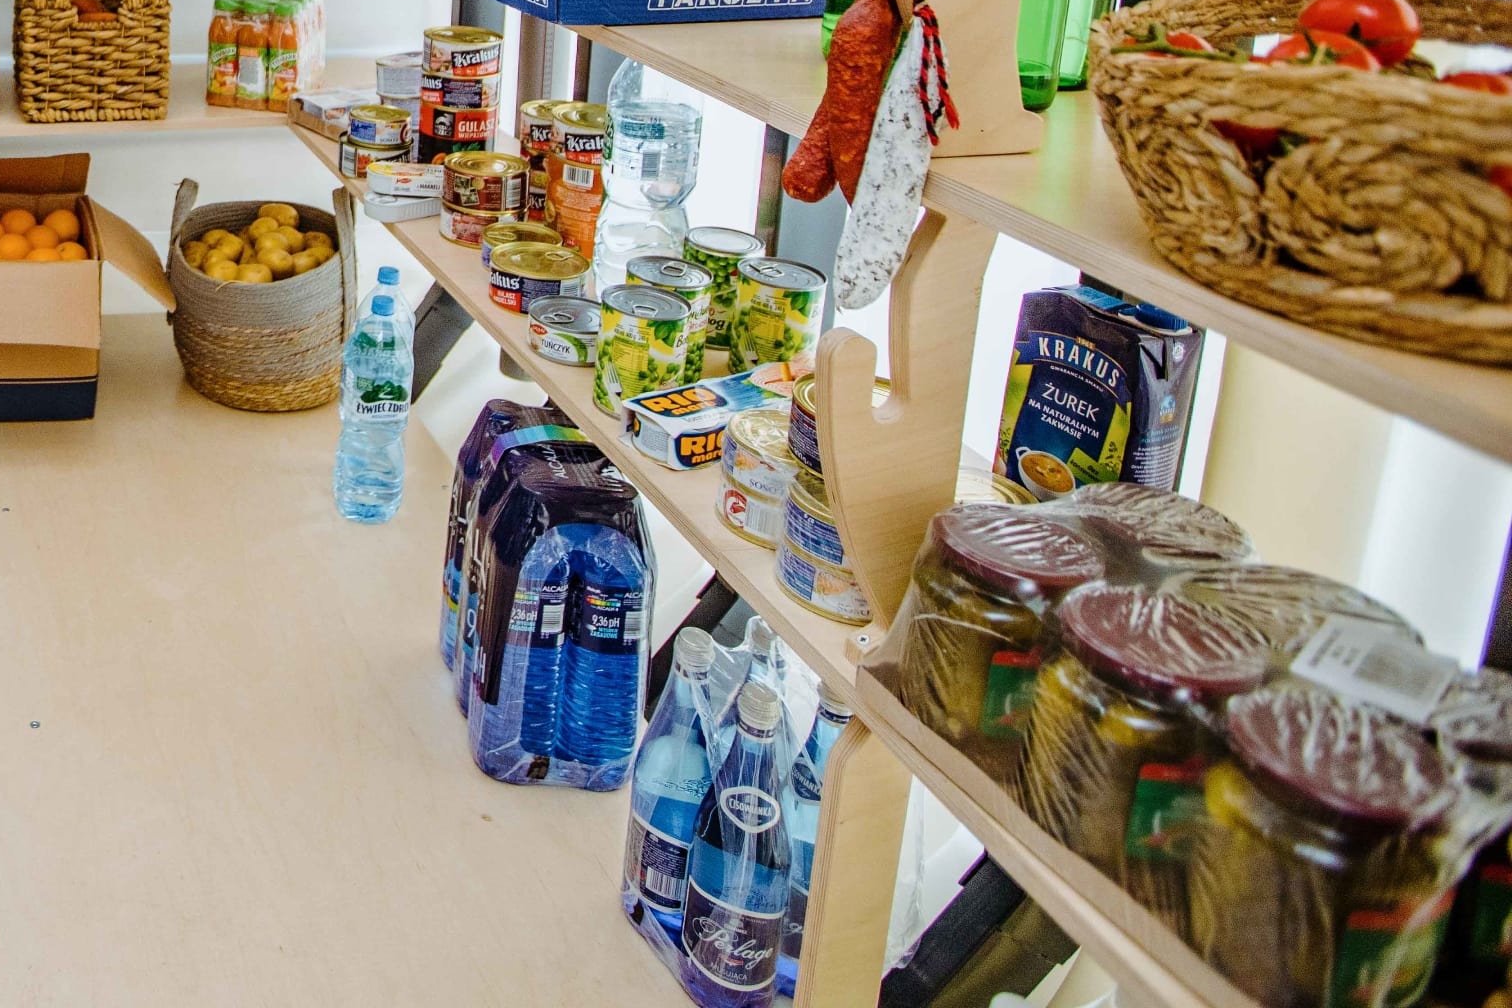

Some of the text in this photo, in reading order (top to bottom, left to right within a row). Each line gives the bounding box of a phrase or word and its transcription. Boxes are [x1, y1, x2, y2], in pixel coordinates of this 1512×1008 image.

[453, 46, 500, 68] Krakus
[1038, 336, 1120, 388] KRAKUS
[639, 387, 717, 413] RIO
[1041, 382, 1100, 422] ŻUREK
[1028, 398, 1100, 440] NA NATURALNYM
[1040, 414, 1083, 440] ZAKWASIE
[608, 617, 620, 628] pH
